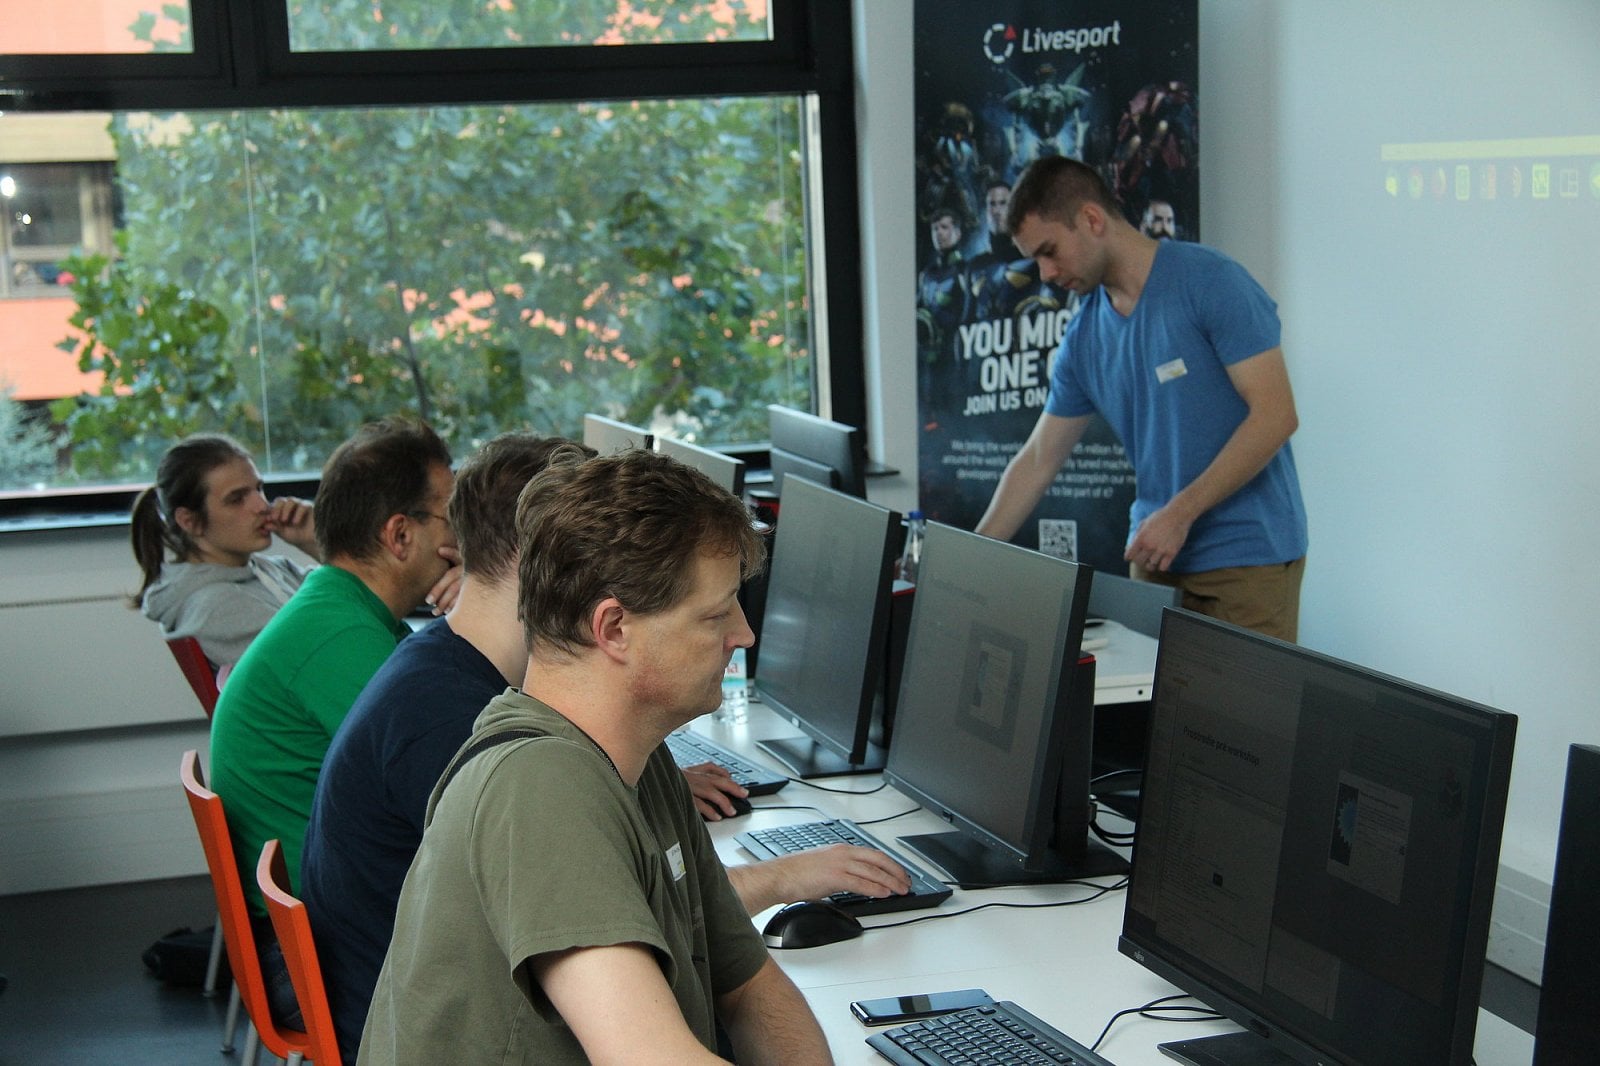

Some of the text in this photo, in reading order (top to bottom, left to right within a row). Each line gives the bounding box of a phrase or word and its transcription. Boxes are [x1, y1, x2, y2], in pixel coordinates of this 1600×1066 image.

[1022, 20, 1120, 54] Livesport
[959, 308, 1072, 360] YOU MIG
[980, 350, 1040, 393] ONE
[963, 393, 997, 416] JOIN
[1000, 390, 1021, 411] US
